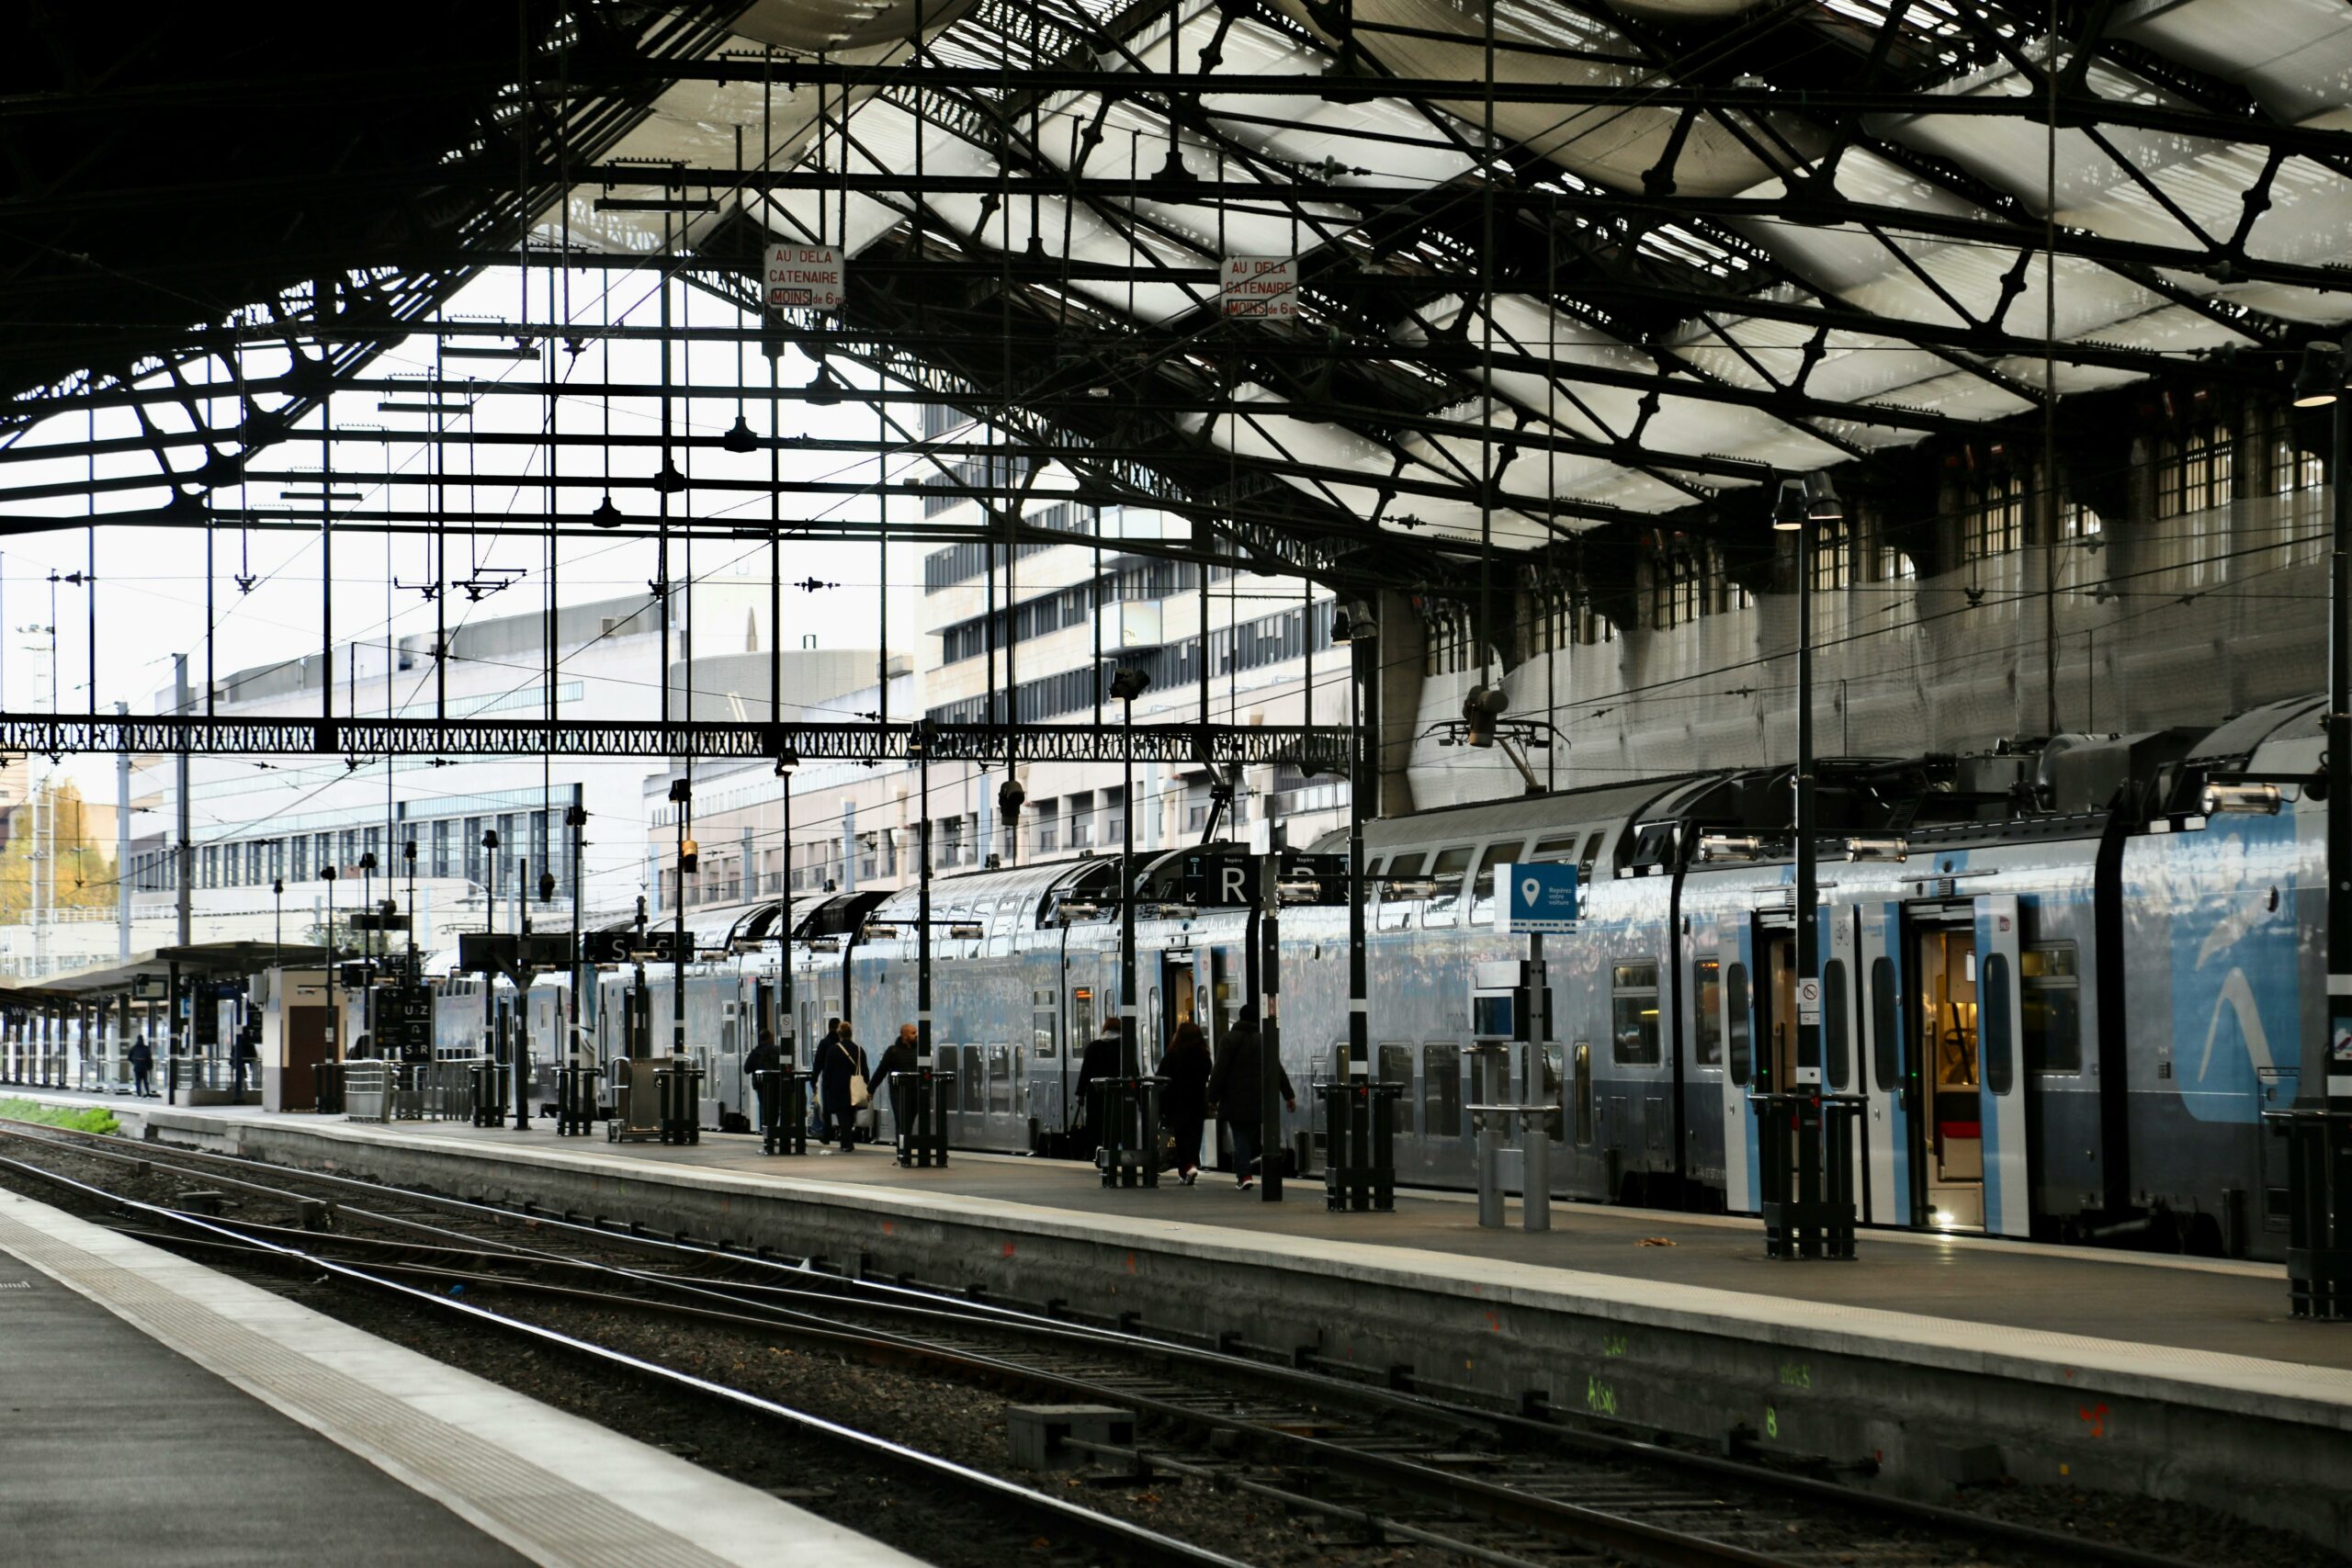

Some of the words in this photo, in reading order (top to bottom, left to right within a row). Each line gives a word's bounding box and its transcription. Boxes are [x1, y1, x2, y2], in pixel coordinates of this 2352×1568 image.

[775, 250, 791, 262] AU
[799, 250, 832, 264] DELA
[1232, 261, 1248, 274] AU
[1255, 262, 1286, 274] DELA
[769, 269, 838, 284] CATENAIRE
[1226, 281, 1293, 294] CATENAIRE
[774, 291, 809, 304] MOINS
[813, 294, 823, 304] de
[825, 292, 833, 305] 6
[1230, 301, 1265, 314] MOINS
[1268, 304, 1277, 314] de
[1280, 302, 1288, 314] 6
[1222, 867, 1248, 903] R
[611, 939, 627, 962] S
[358, 969, 371, 986] T
[404, 1005, 413, 1015] U
[420, 1005, 428, 1015] Z
[404, 1044, 413, 1055] S
[420, 1044, 428, 1055] R
